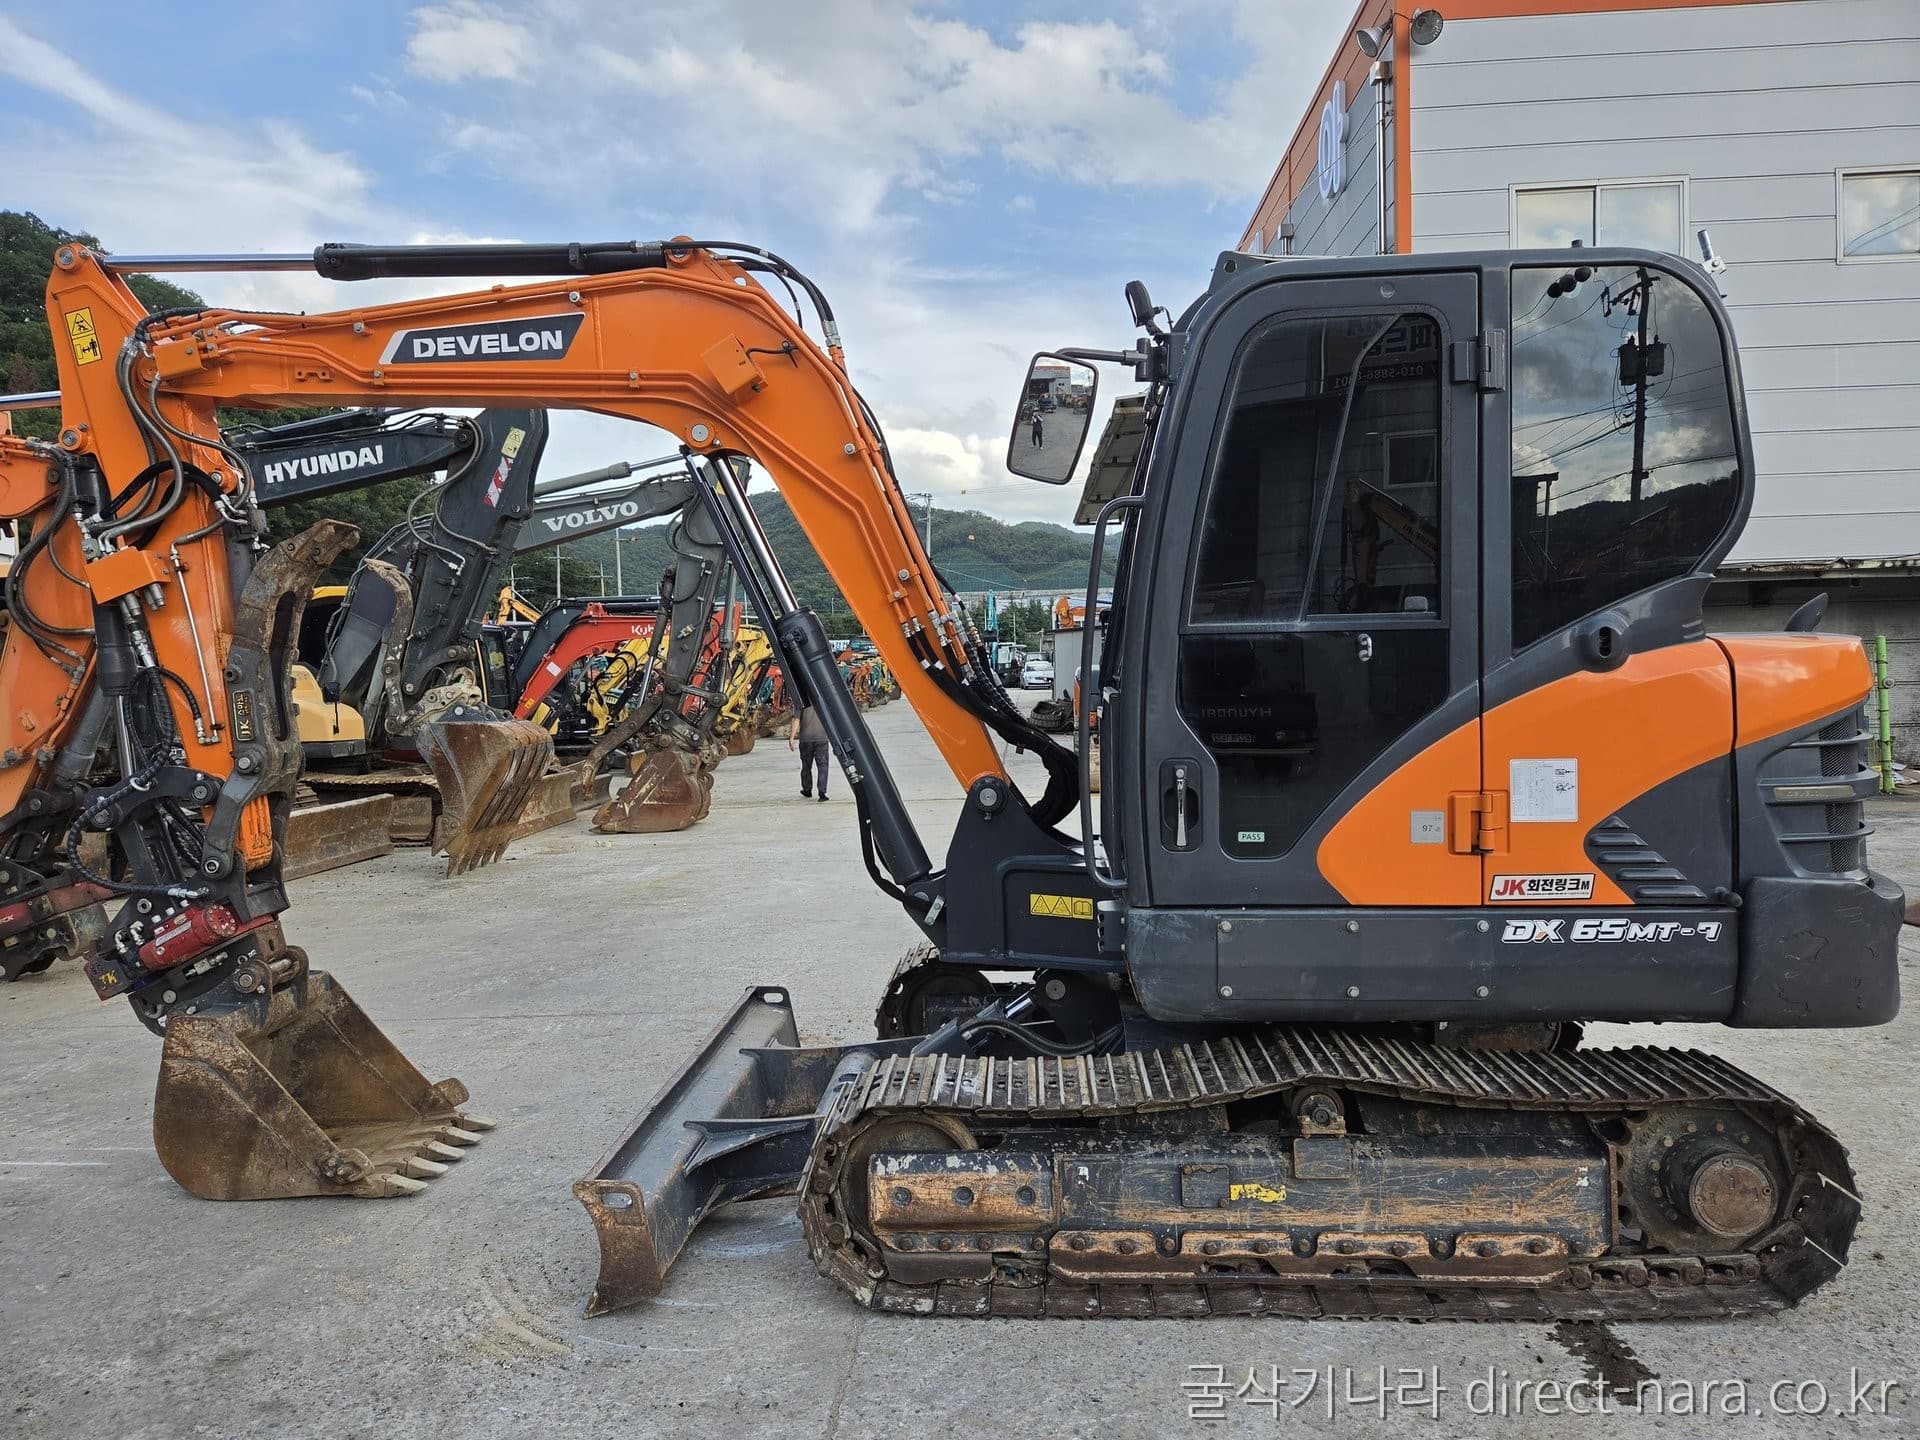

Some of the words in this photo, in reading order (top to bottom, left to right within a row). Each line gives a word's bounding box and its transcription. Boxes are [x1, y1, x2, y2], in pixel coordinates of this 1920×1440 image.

[413, 330, 563, 358] DEVELON
[264, 445, 383, 483] HYUNDAI
[542, 501, 638, 531] VOLVO
[1241, 833, 1262, 841] PASS
[1502, 919, 1566, 943] DX
[1570, 919, 1722, 942] 65MT-7
